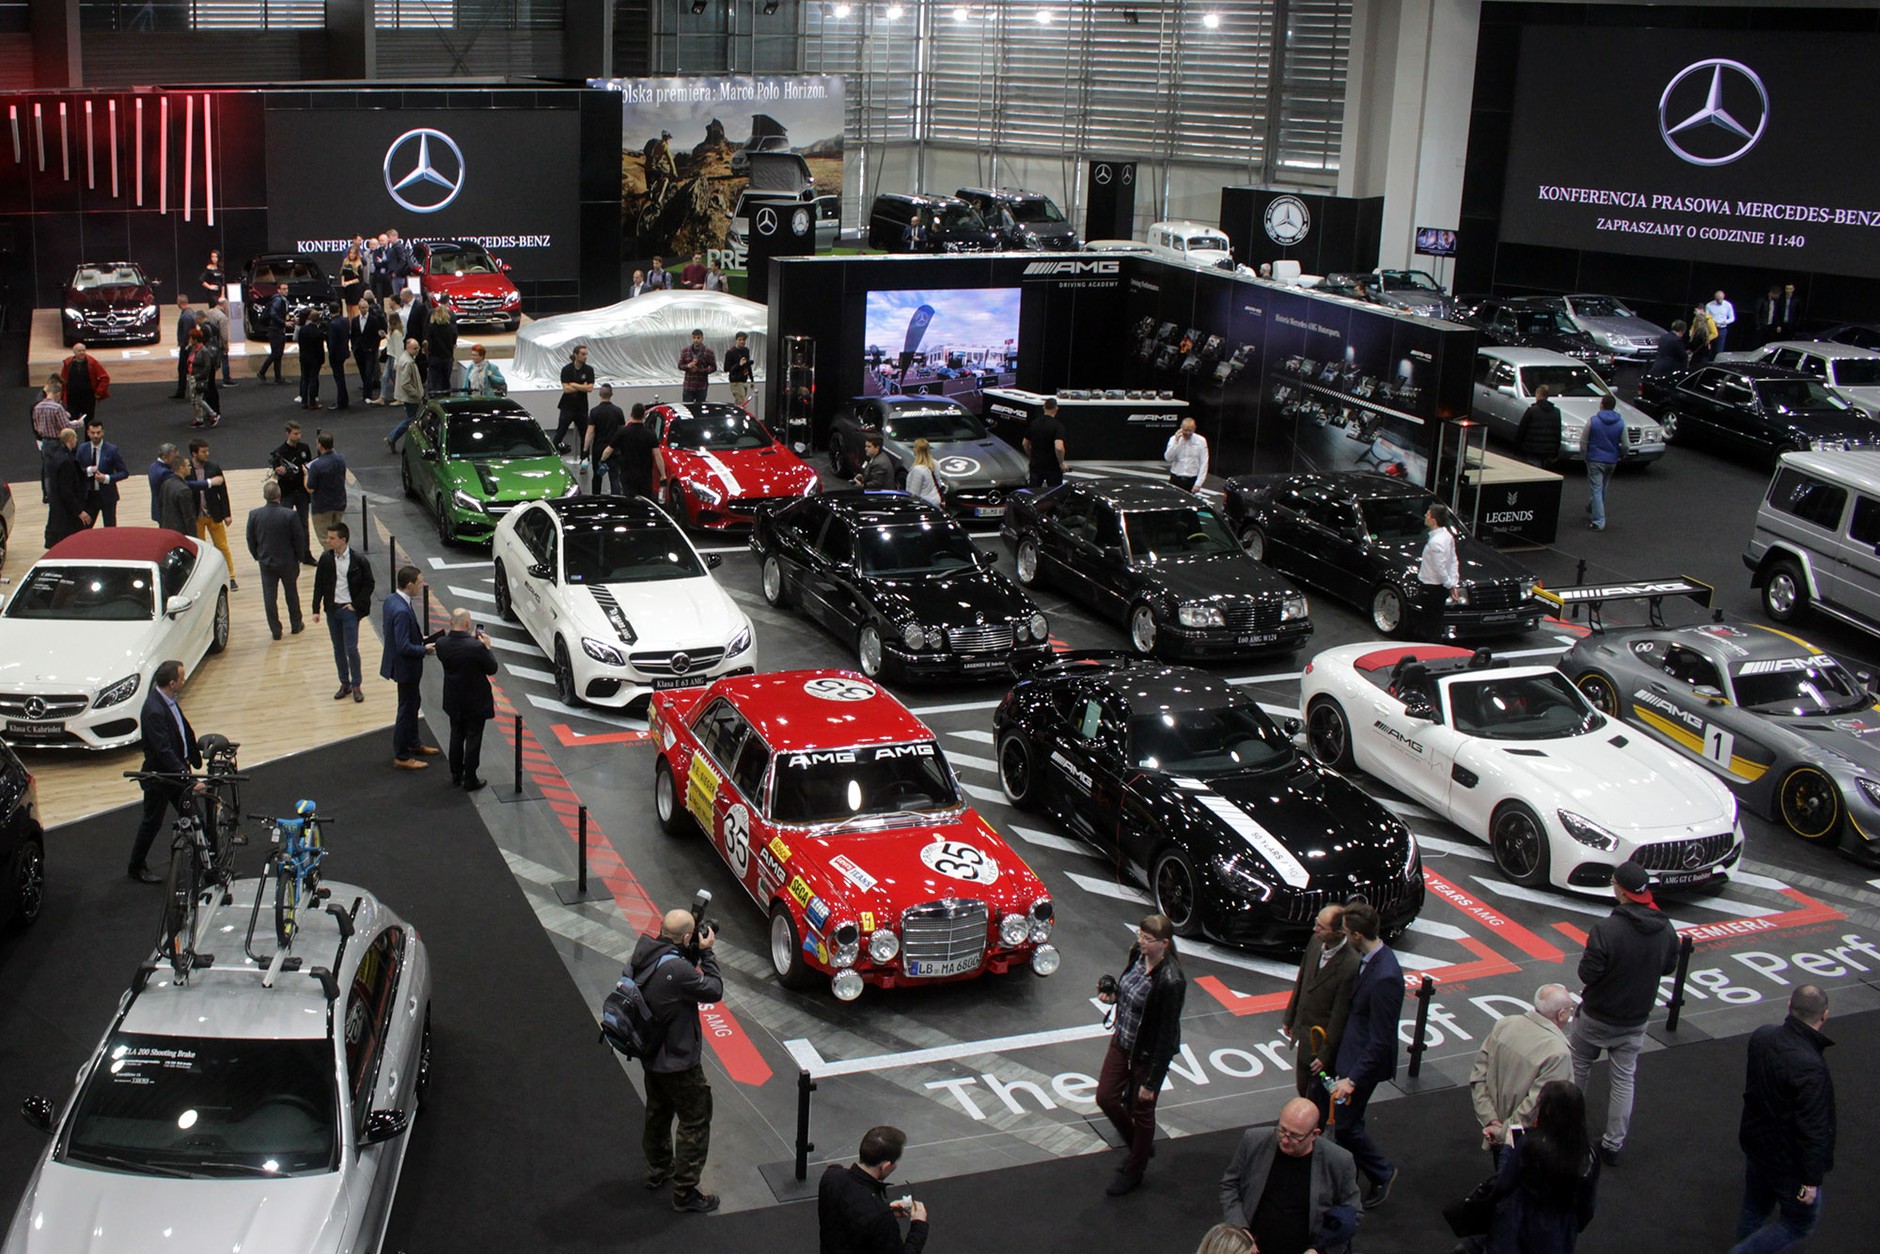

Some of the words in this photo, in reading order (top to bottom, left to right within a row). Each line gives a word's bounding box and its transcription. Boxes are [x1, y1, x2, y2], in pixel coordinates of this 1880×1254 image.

[656, 86, 717, 107] premiera:
[719, 82, 754, 101] Marco
[757, 82, 780, 100] Polo
[784, 81, 829, 99] Horizon.
[1538, 185, 1647, 209] KONFERENCJA
[1651, 194, 1732, 216] PRASOWA
[1736, 201, 1880, 228] MERCEDES-BENZ
[451, 235, 551, 248] CEDES-BENZ
[1596, 217, 1685, 238] ZAPRASZAMY
[1687, 225, 1697, 239] O
[1699, 227, 1765, 245] GODZINIE
[1768, 232, 1805, 248] 11:40
[1052, 260, 1120, 275] AMG
[921, 408, 962, 417] AMG
[1000, 407, 1028, 418] AMG
[948, 459, 968, 473] 3
[1485, 510, 1534, 523] LEGENDS
[1601, 582, 1694, 598] AMG
[1774, 654, 1836, 672] AMG
[656, 680, 674, 689] Klasa
[675, 680, 680, 688] E
[680, 679, 689, 687] 63
[689, 677, 705, 686] AMG
[806, 679, 875, 700] 35
[1656, 700, 1703, 727] AMG
[9, 724, 26, 733] Klasa
[26, 725, 32, 733] C
[32, 724, 62, 734] Kabriolet
[1387, 728, 1424, 754] AMG
[1712, 731, 1725, 761] 1
[788, 752, 857, 769] AMG
[874, 744, 935, 761] AMG
[1062, 760, 1093, 788] AMG
[723, 813, 748, 868] 35
[759, 847, 787, 884] AMG
[935, 842, 984, 880] 35
[850, 869, 873, 888] JEANS
[1664, 877, 1679, 885] AMG
[790, 878, 810, 905] SECA
[1428, 879, 1474, 907] YEARS
[1468, 906, 1505, 927] AMG
[918, 963, 933, 975] LB
[941, 961, 955, 975] MA
[703, 1013, 734, 1038] AMG
[137, 1047, 150, 1056] 200
[150, 1047, 177, 1058] Shooting
[177, 1049, 196, 1059] Brake
[924, 1072, 1100, 1121] The
[1397, 1003, 1474, 1048] of
